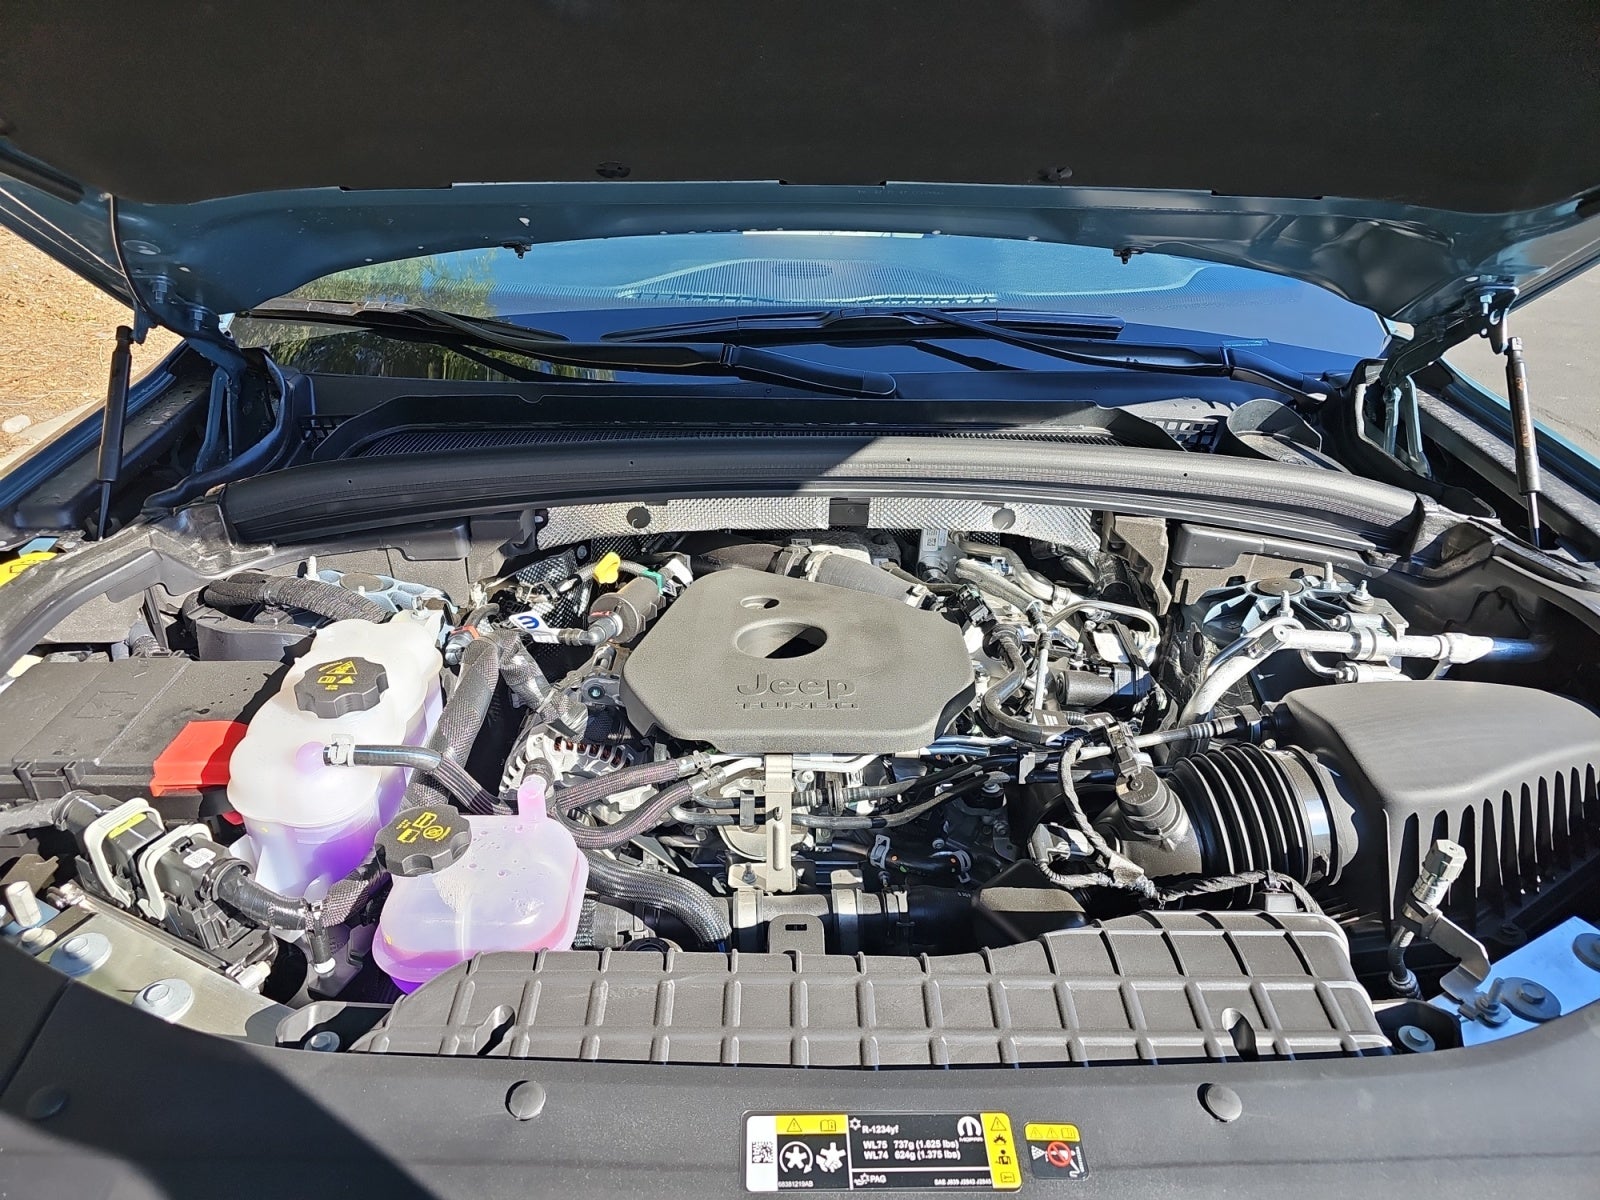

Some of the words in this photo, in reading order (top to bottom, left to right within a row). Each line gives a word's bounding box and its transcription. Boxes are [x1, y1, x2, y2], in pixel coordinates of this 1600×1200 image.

[737, 673, 857, 700] Jeep
[735, 702, 861, 711] TURBO
[862, 1125, 899, 1136] R-1234yf
[863, 1140, 888, 1150] WL75
[893, 1140, 915, 1151] 737g
[942, 1139, 960, 1150] lbs)
[864, 1150, 889, 1160] WL74
[894, 1150, 916, 1161] 624g
[943, 1150, 961, 1160] lbs)
[870, 1174, 887, 1183] PAG
